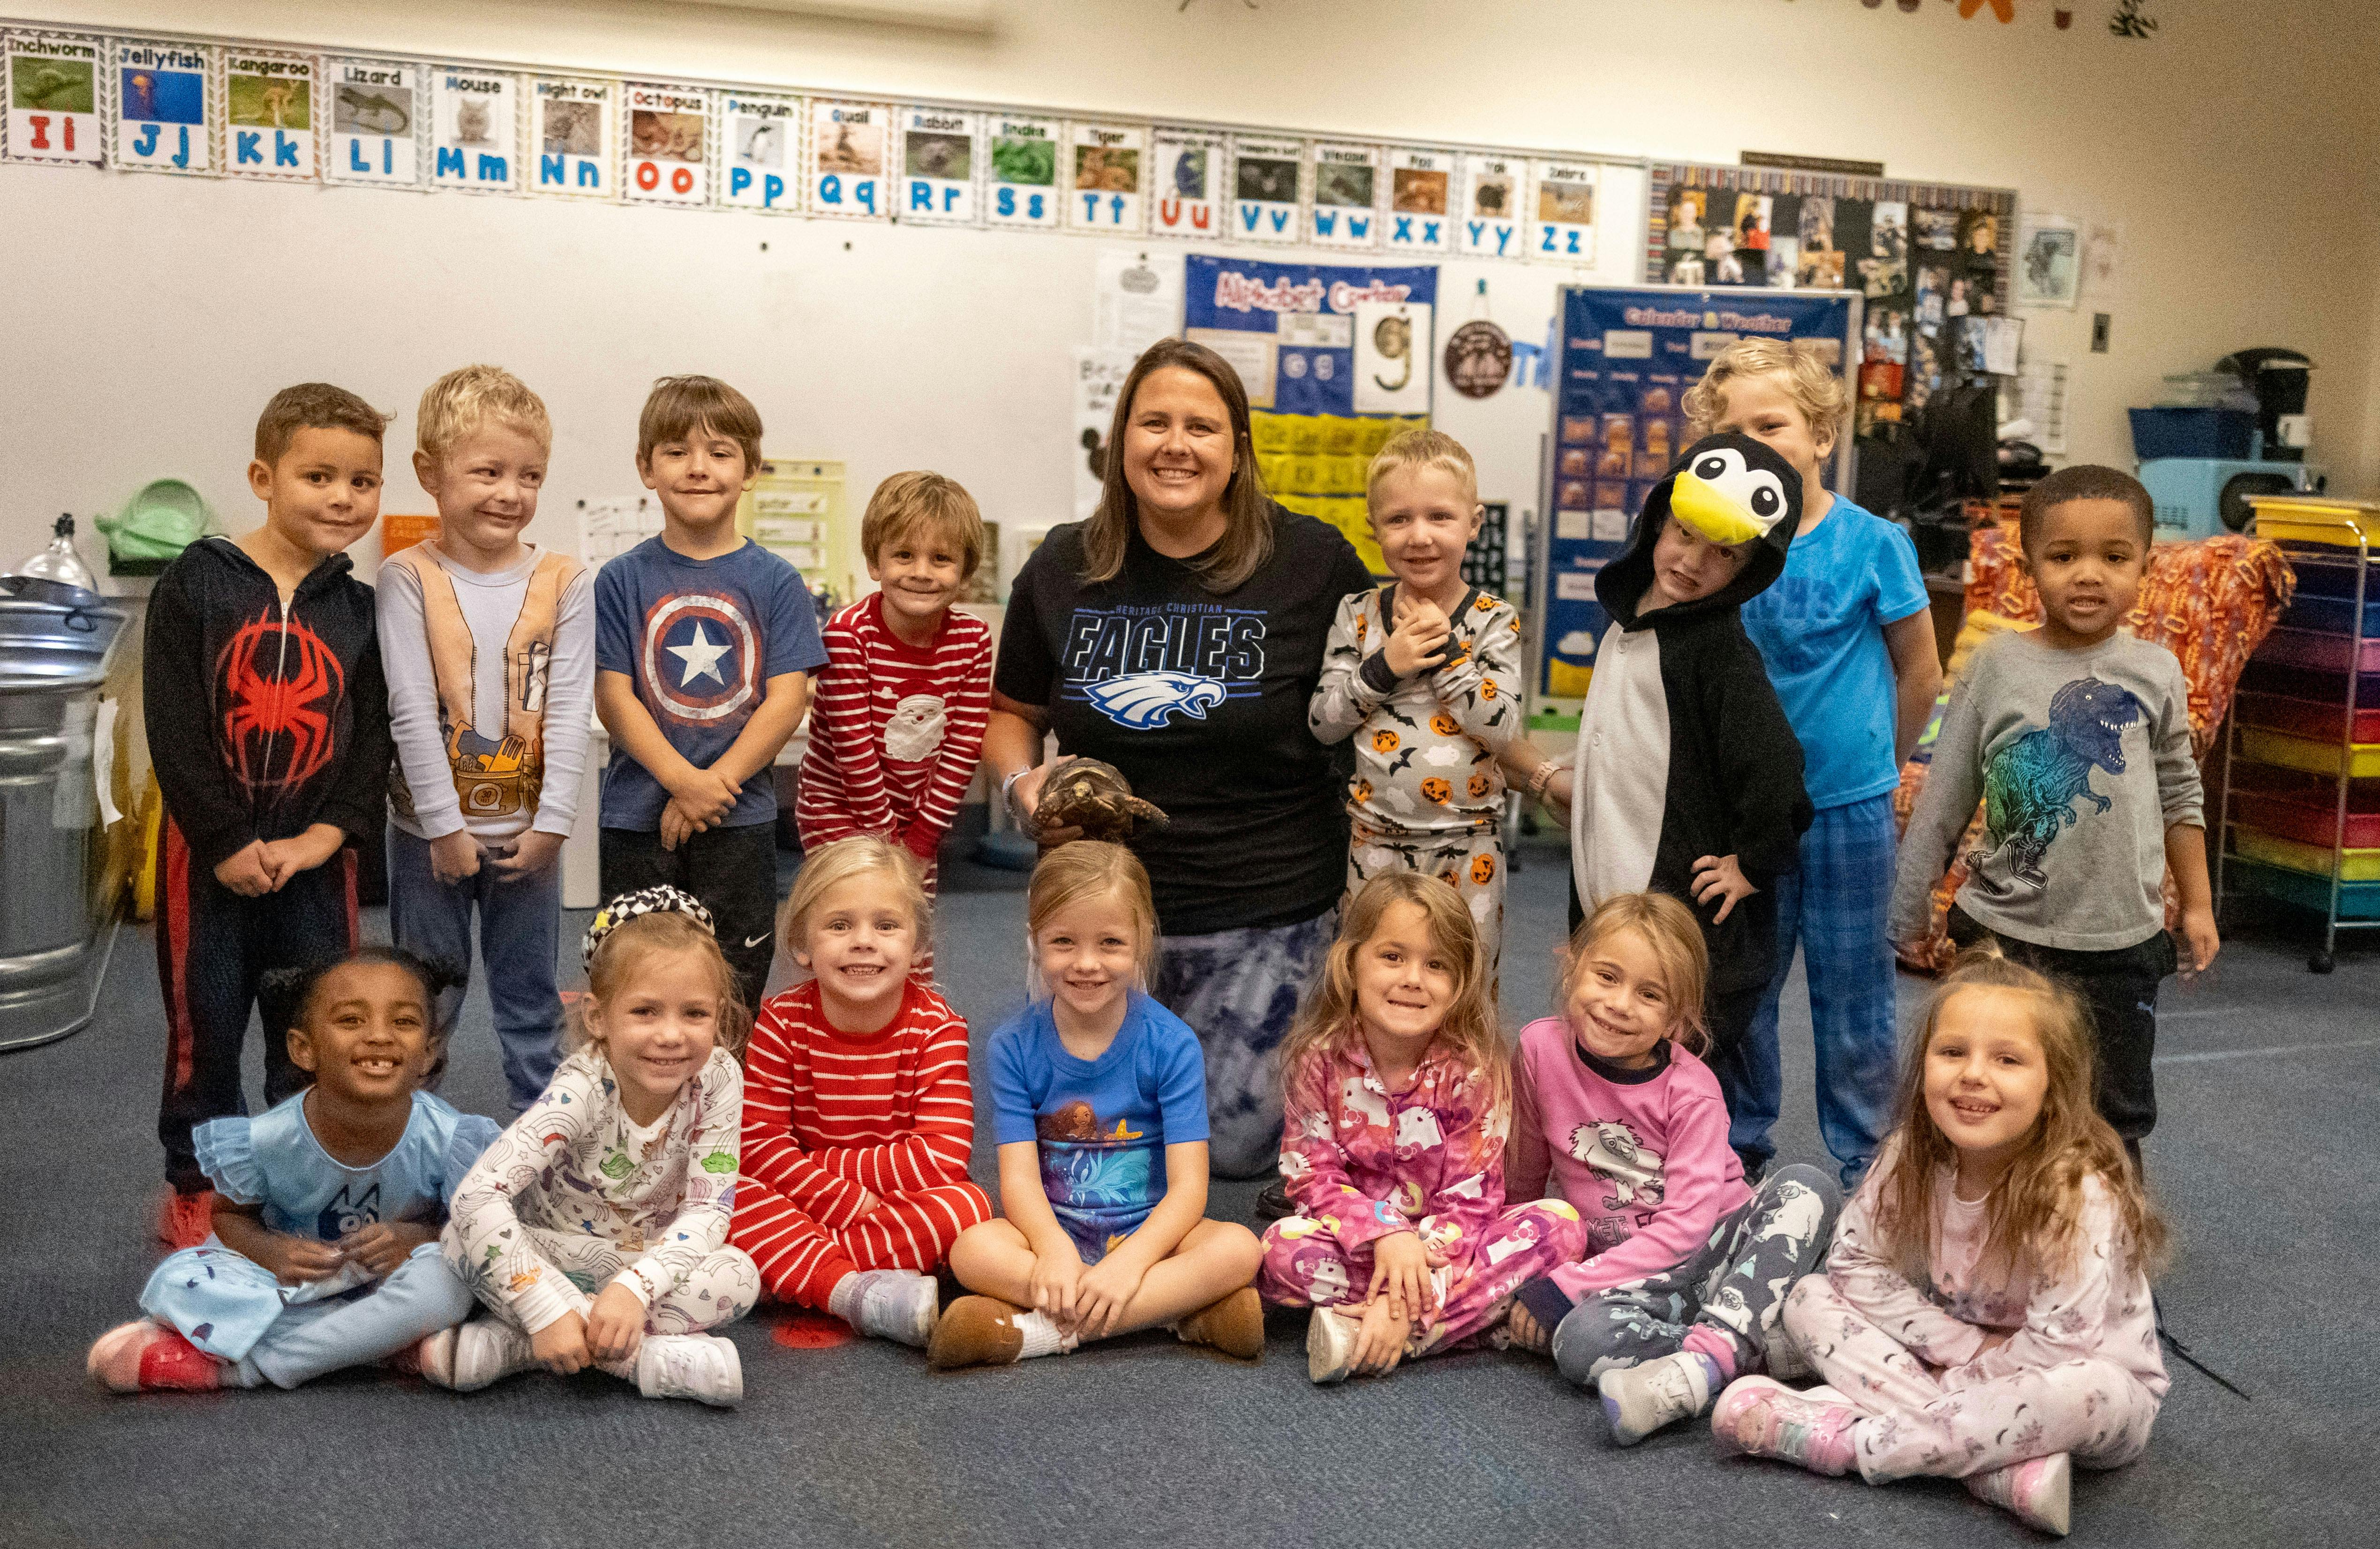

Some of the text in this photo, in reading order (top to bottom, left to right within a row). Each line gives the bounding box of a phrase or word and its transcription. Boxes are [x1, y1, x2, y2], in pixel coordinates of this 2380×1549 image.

[7, 37, 95, 58] Inchworm
[119, 48, 205, 70] Jellyfish
[228, 56, 309, 75] Kangaroo
[344, 67, 401, 85] Lizard
[446, 76, 501, 93] Mouse
[536, 81, 609, 99] Night owl
[633, 91, 702, 114] Octopus
[729, 99, 793, 118] Penguin
[1115, 602, 1222, 616] HERITAGE CHRISTIAN
[1062, 614, 1266, 682] EAGLES
[481, 790, 492, 798] 30
